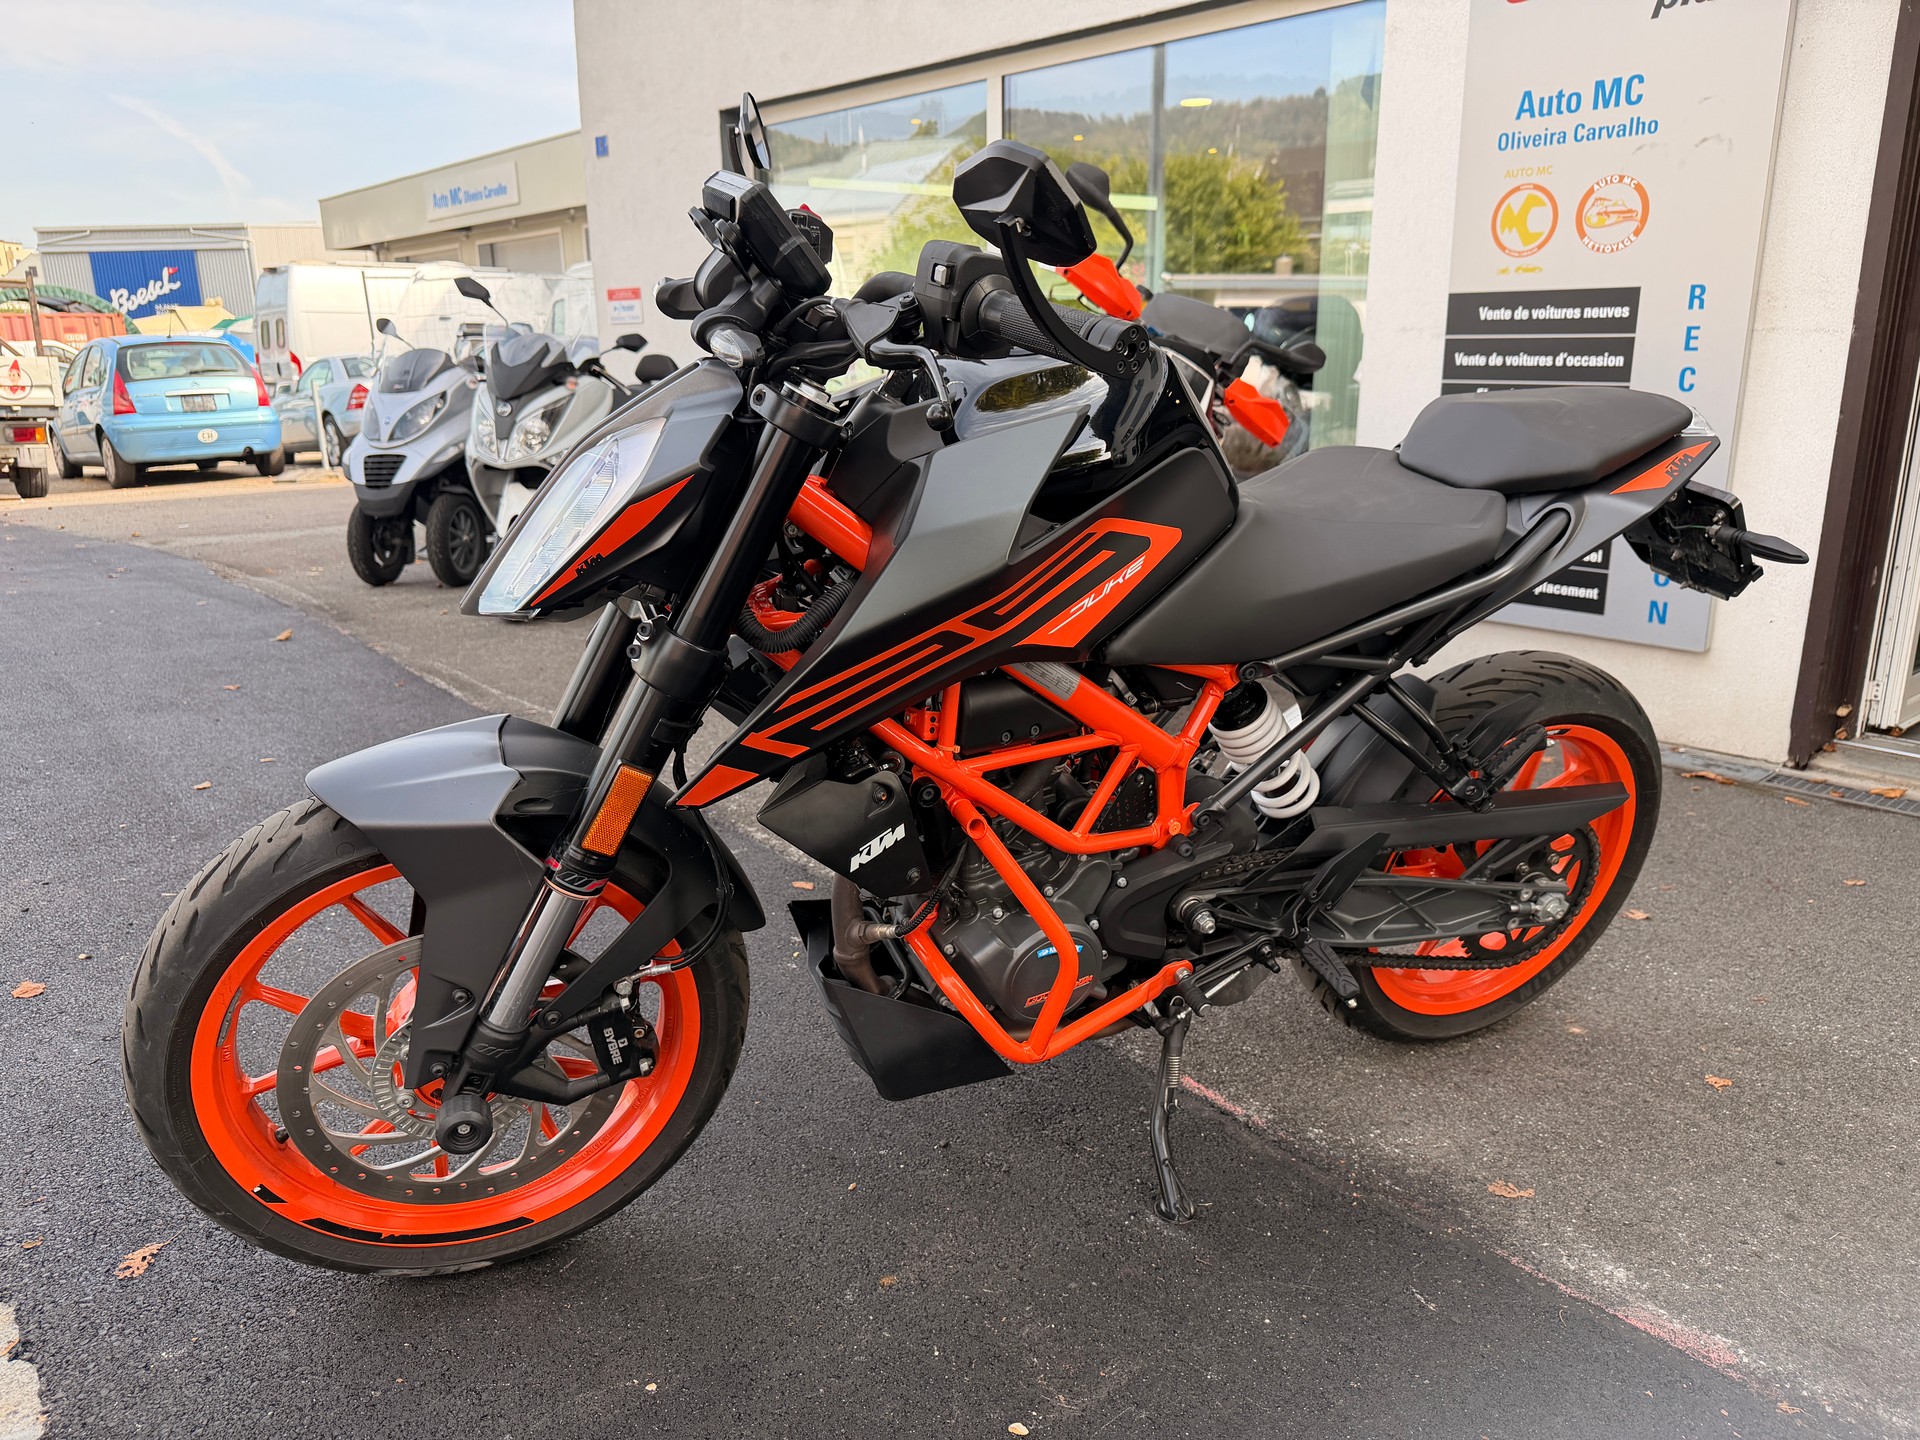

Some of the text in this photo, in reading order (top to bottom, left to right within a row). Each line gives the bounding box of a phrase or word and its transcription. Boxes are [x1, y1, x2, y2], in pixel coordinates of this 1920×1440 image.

[1515, 74, 1645, 120] Auto MC
[1497, 116, 1659, 151] Oliveira Carvalho
[1504, 165, 1553, 179] AUTO MC
[1593, 175, 1638, 192] AUTO MC
[433, 192, 449, 209] Auto
[449, 186, 463, 206] MC
[1582, 232, 1637, 254] NETTOYAGE
[110, 266, 181, 314] Boesch
[1479, 305, 1630, 321] Vente de voitures neuves
[1454, 352, 1624, 367] Vente de voitures d'occasion
[1048, 555, 1146, 634] DUKE
[1533, 582, 1599, 600] placement
[850, 823, 905, 873] KTM
[603, 1027, 623, 1065] BYBRE
